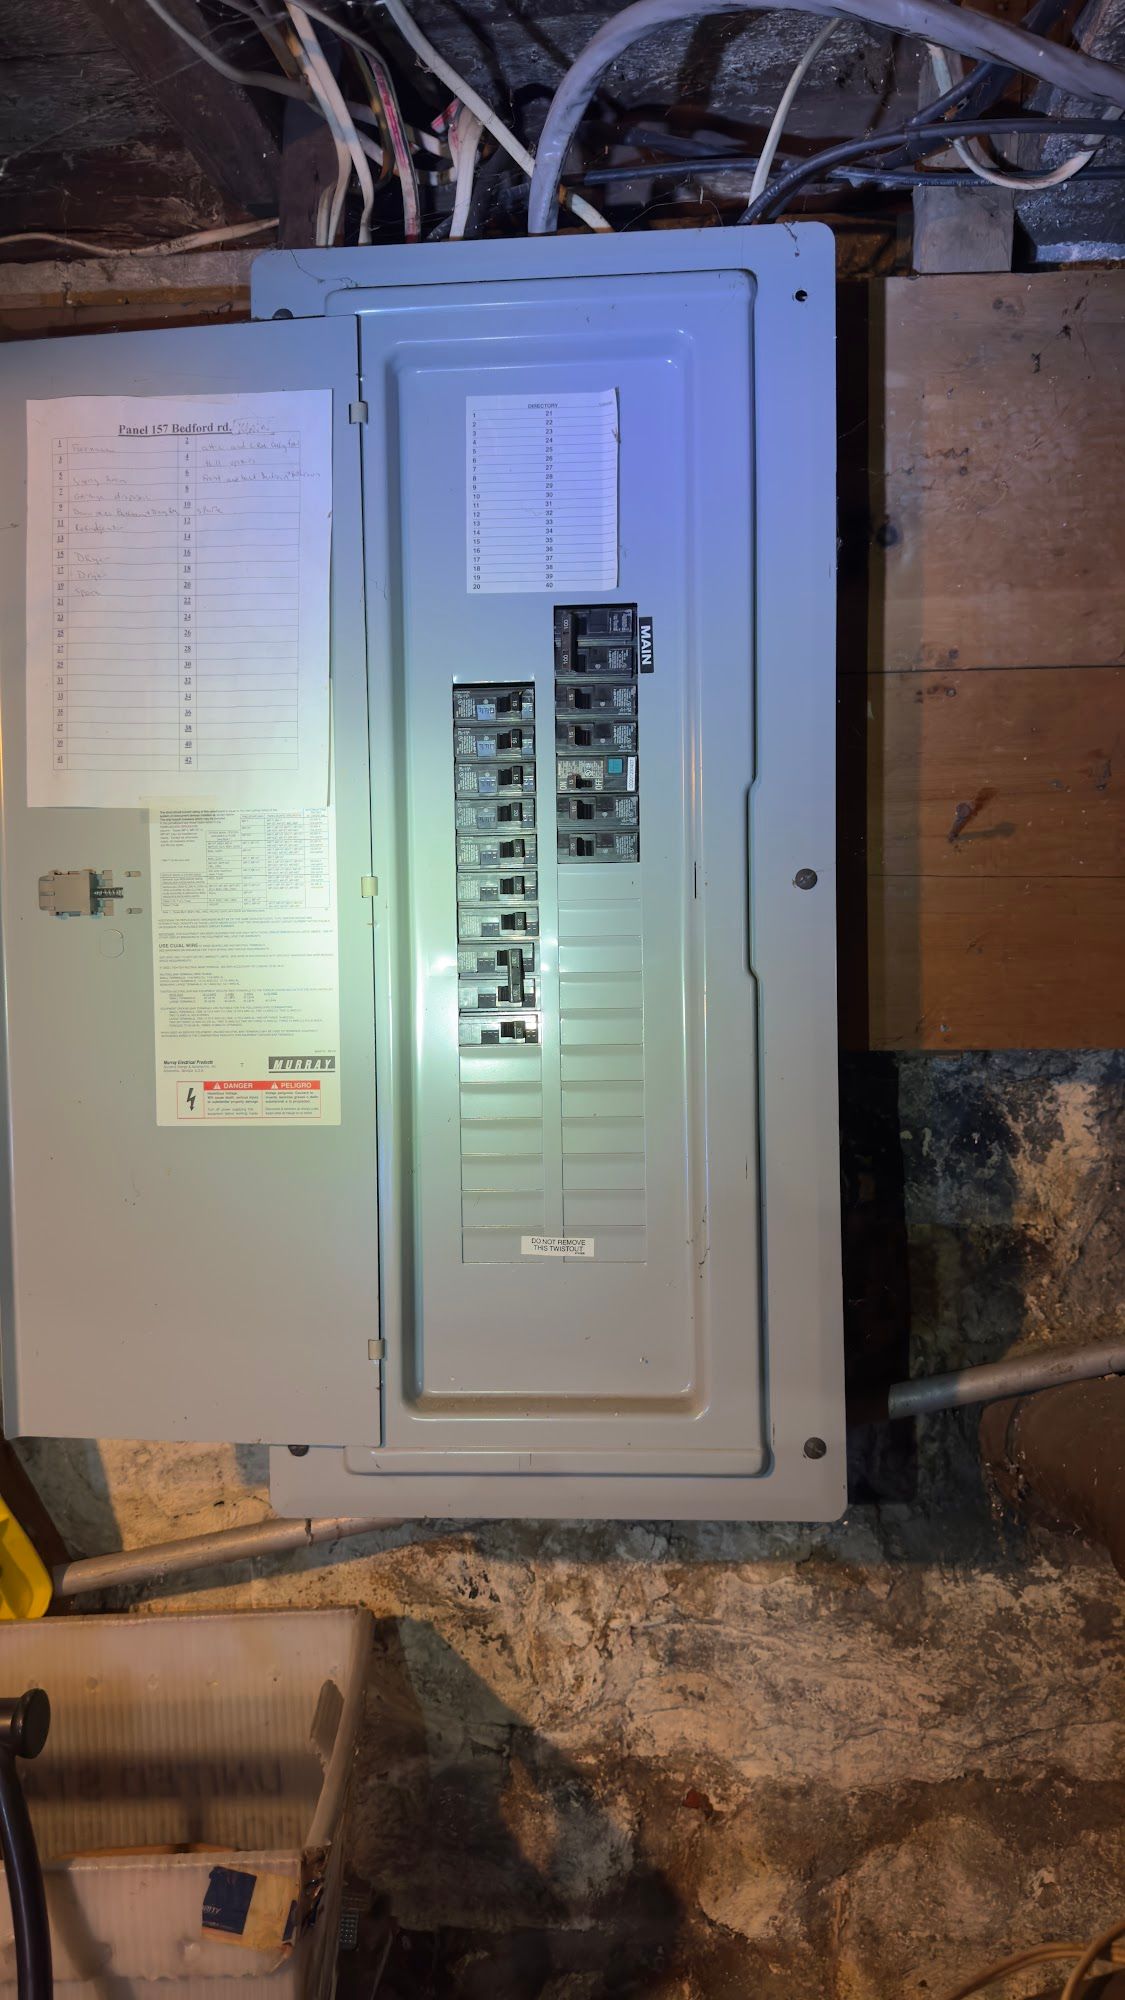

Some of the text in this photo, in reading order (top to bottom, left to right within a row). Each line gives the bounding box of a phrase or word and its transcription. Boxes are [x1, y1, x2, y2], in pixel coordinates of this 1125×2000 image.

[119, 424, 149, 435] Panel
[151, 424, 168, 434] 157
[172, 423, 212, 434] Bedford
[215, 423, 232, 432] rd.
[641, 625, 652, 665] MAIN
[560, 782, 567, 790] ON
[273, 1059, 332, 1070] MURRAY
